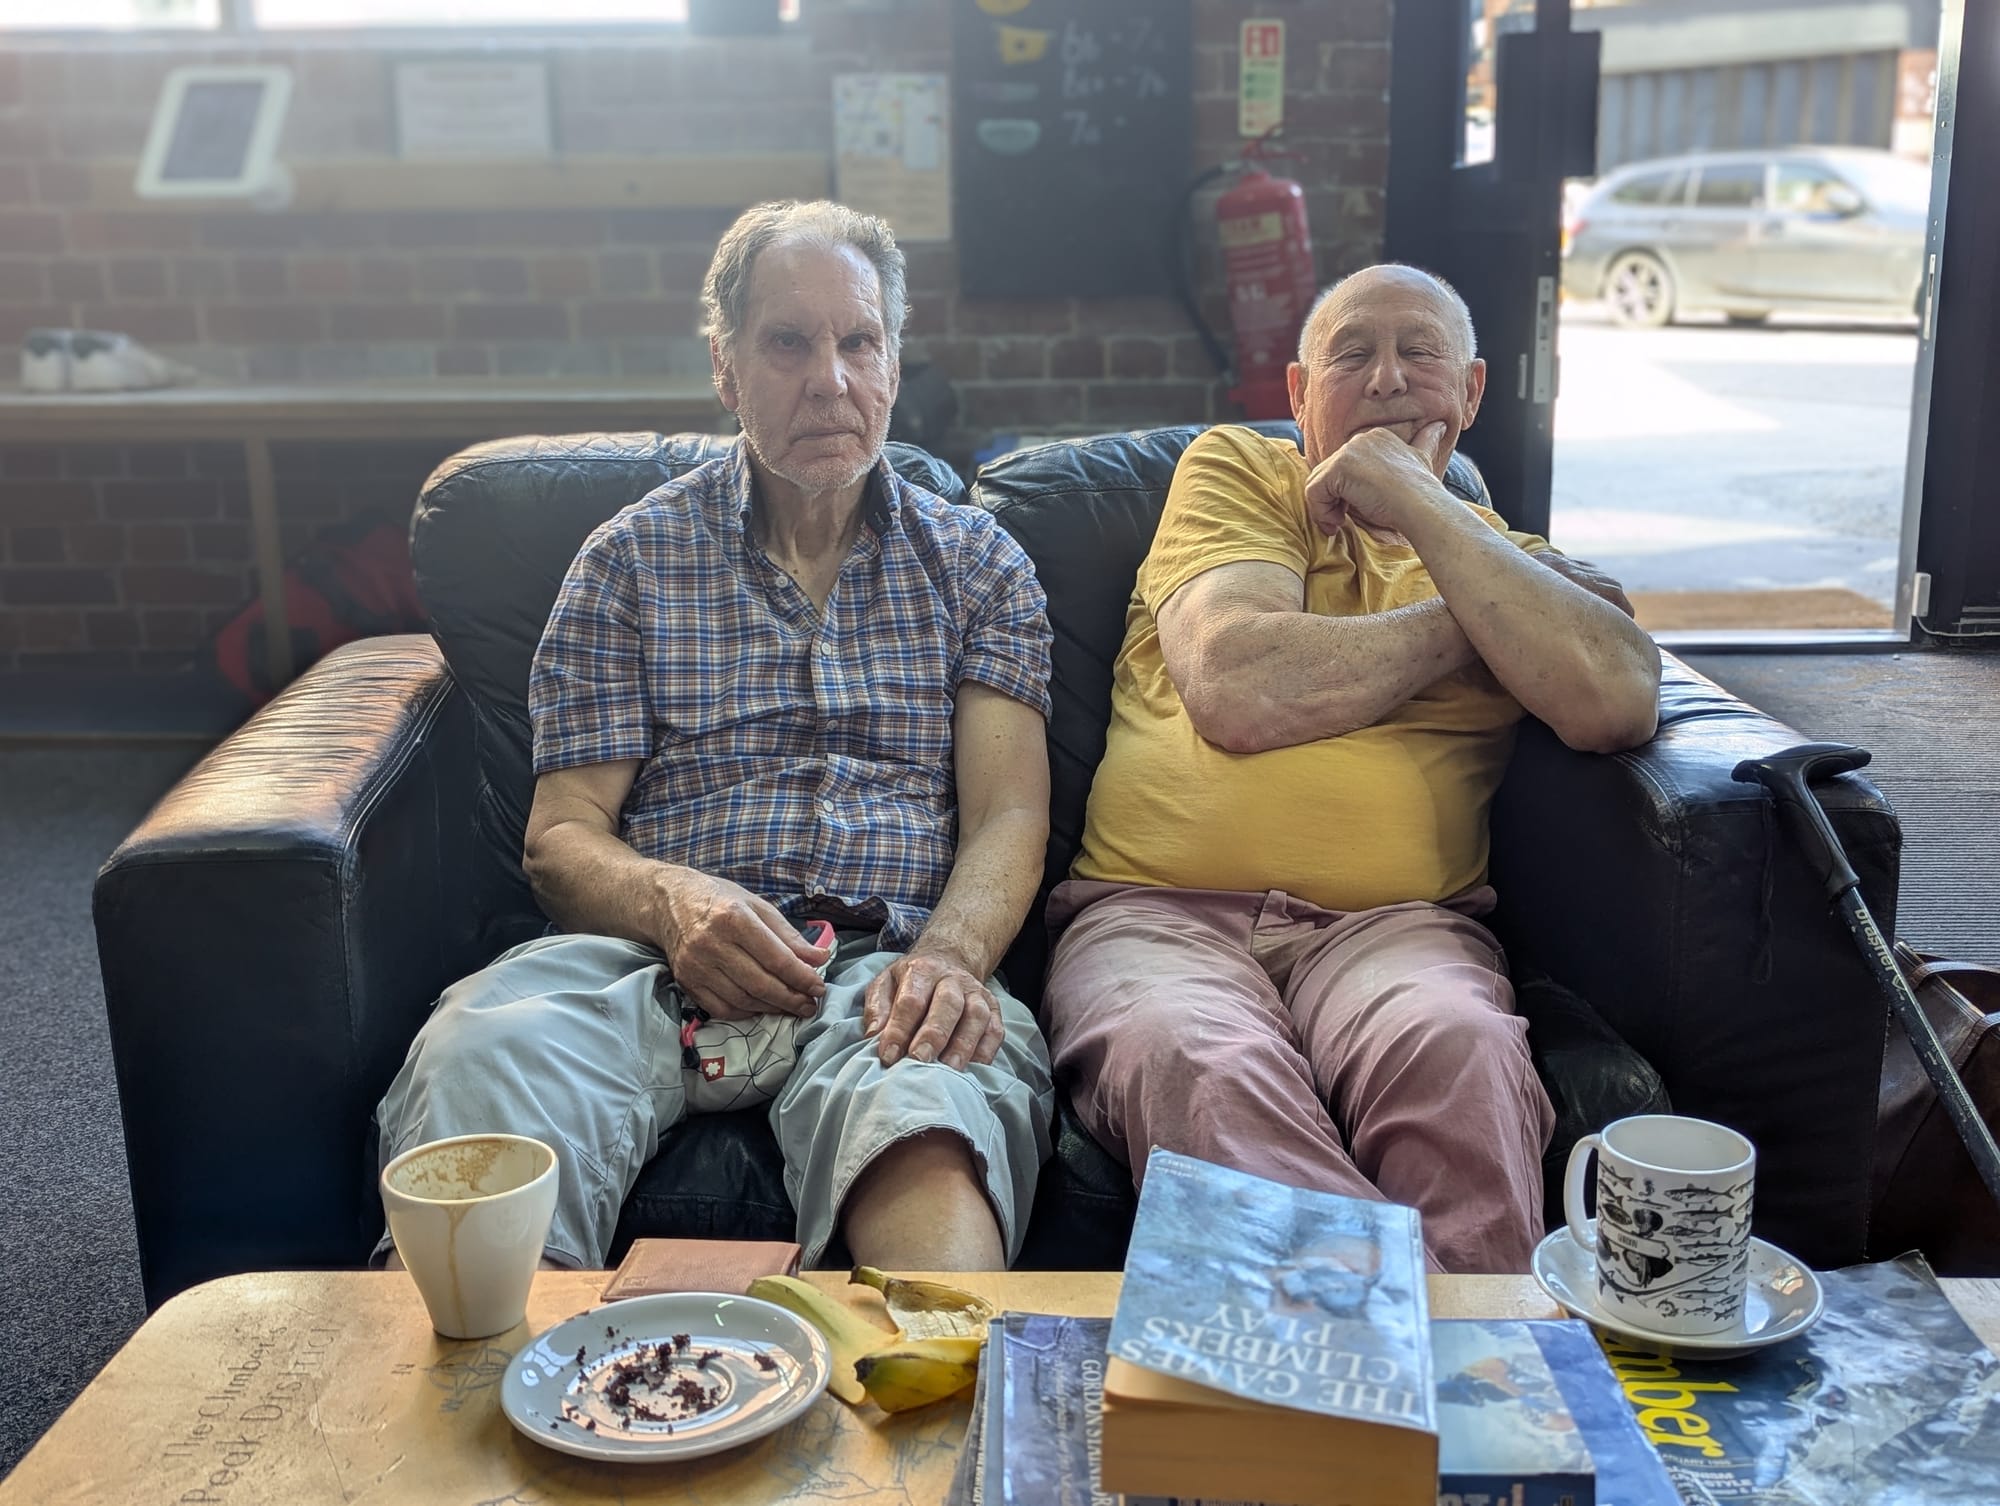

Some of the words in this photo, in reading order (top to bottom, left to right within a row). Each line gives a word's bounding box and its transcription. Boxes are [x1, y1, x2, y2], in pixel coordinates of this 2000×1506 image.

[1144, 1316, 1400, 1384] CLIMBERS
[1204, 1302, 1336, 1346] PLAY
[1081, 1359, 1104, 1426] GORDON
[1120, 1338, 1300, 1399] GAMES
[1318, 1378, 1420, 1418] THE
[180, 1434, 268, 1503] Peak
